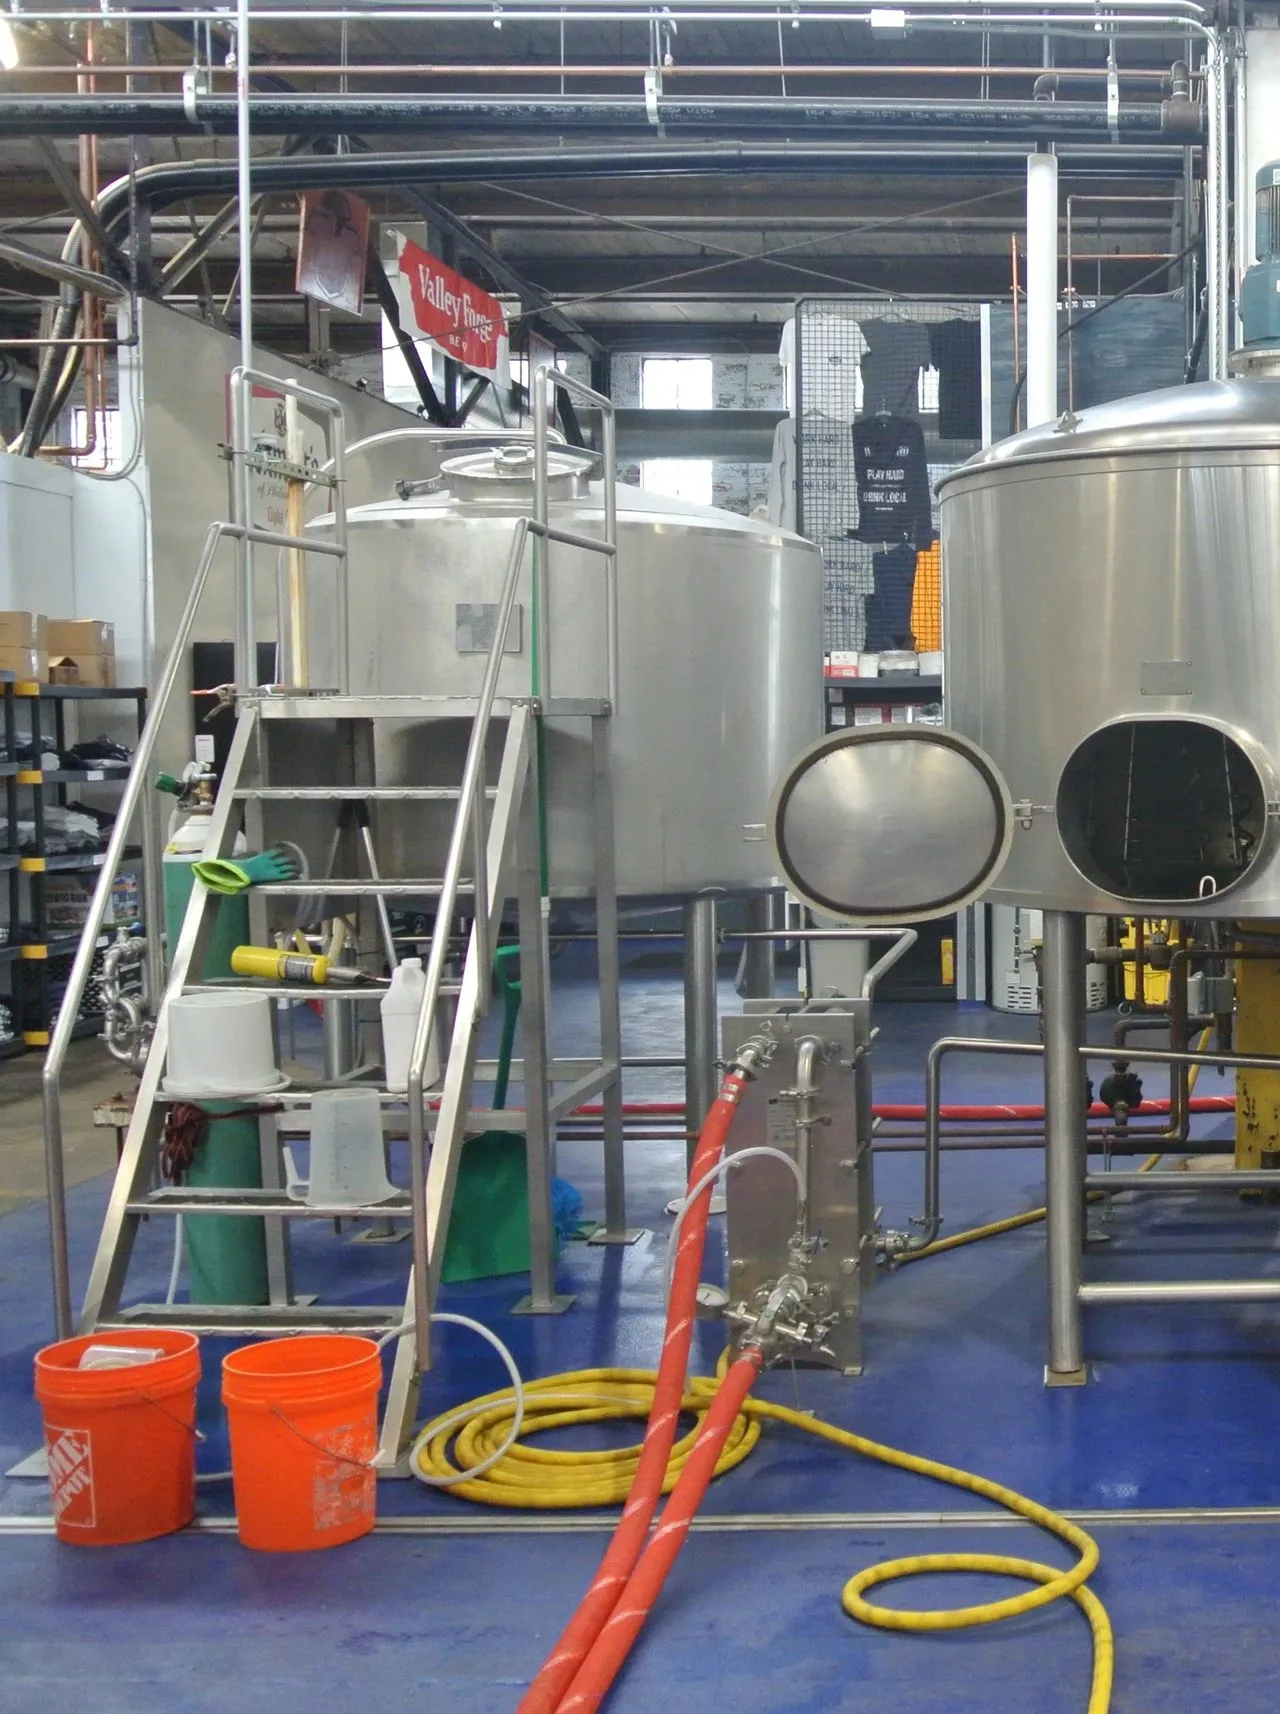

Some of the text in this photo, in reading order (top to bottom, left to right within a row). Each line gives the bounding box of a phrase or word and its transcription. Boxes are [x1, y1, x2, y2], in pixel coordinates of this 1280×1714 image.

[418, 263, 492, 343] Valley Forge
[448, 334, 469, 352] BER
[866, 468, 885, 480] PLAY
